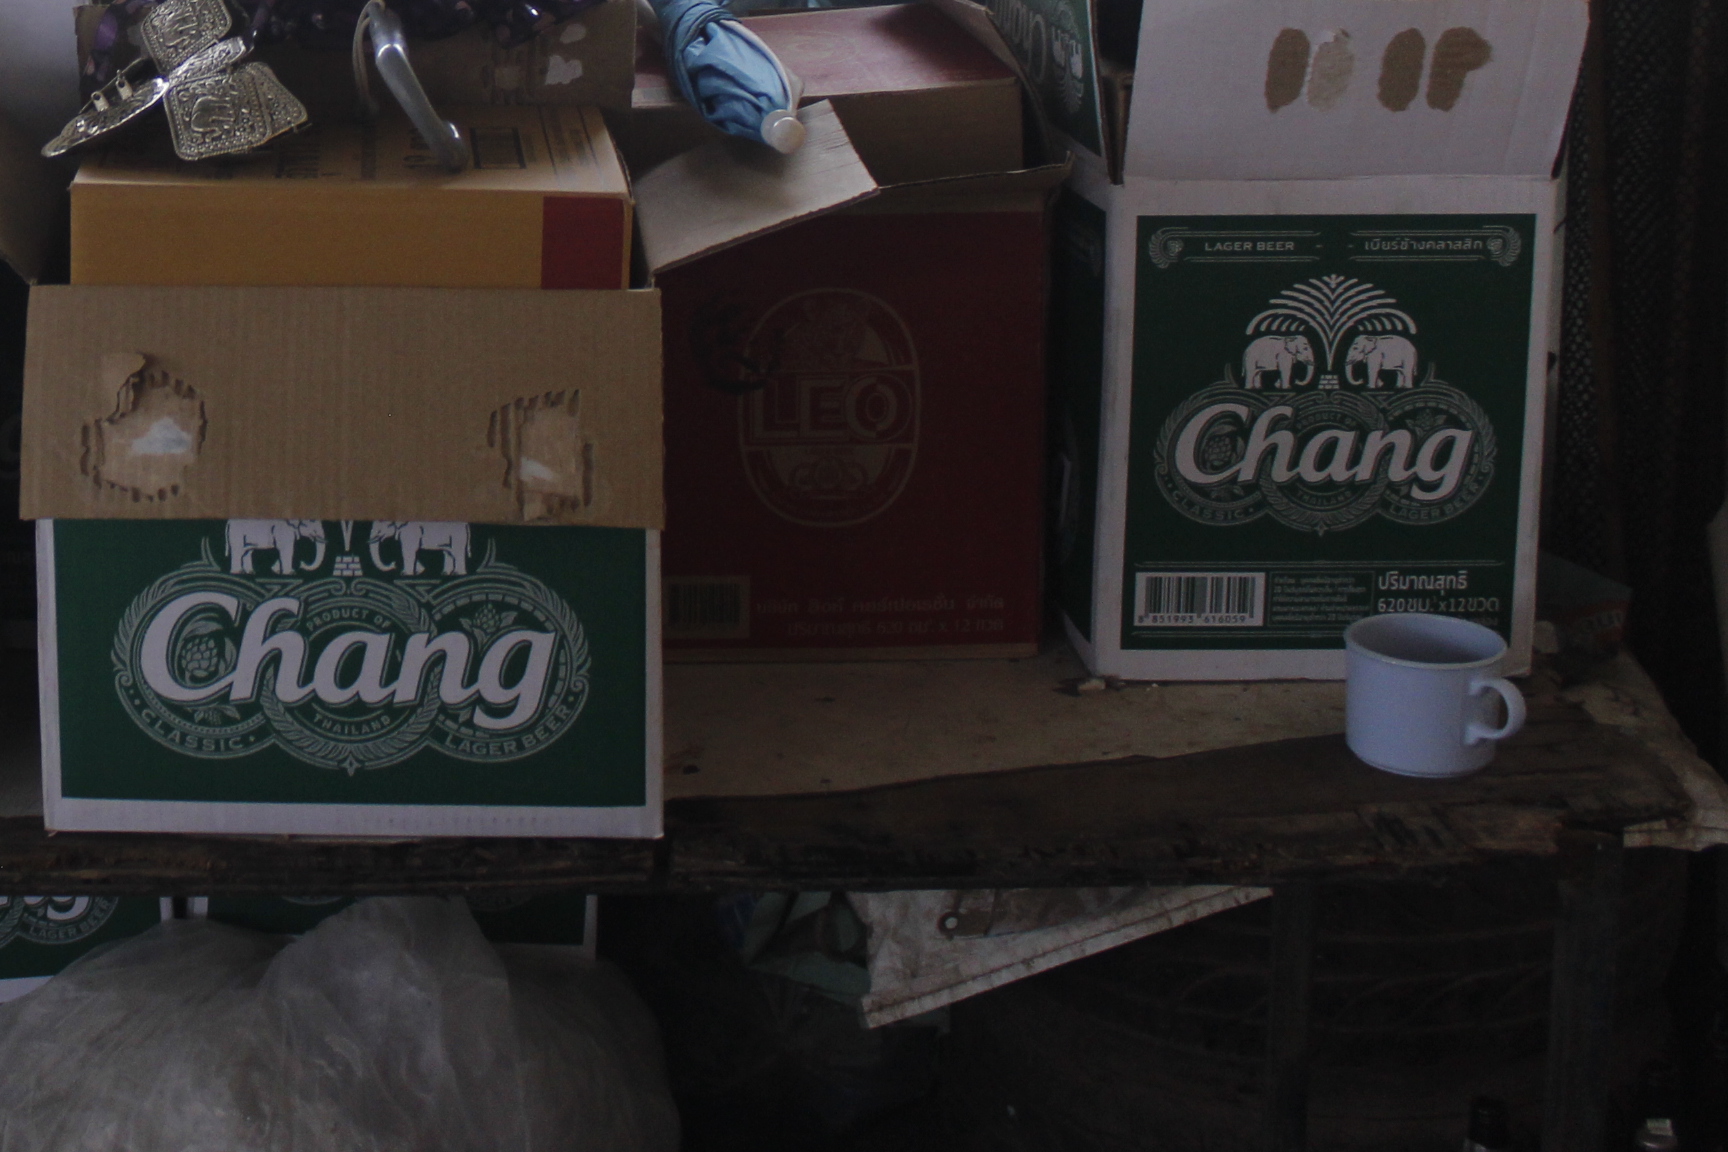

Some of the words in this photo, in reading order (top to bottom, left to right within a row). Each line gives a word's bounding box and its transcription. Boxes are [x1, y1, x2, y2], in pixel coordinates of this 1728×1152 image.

[1204, 240, 1253, 252] LAGER
[1256, 241, 1295, 252] BEER
[751, 372, 912, 443] LEO
[1174, 403, 1474, 502] Chang
[1172, 491, 1244, 521] CLASSIC
[1390, 507, 1441, 522] LAGER
[1378, 569, 1469, 596] ปริมาณสุทธิ
[139, 591, 558, 731] Chang
[140, 708, 243, 752] CLASSIC
[312, 713, 393, 736] THAILAND
[444, 732, 518, 757] LAGER
[518, 704, 574, 754] BEER
